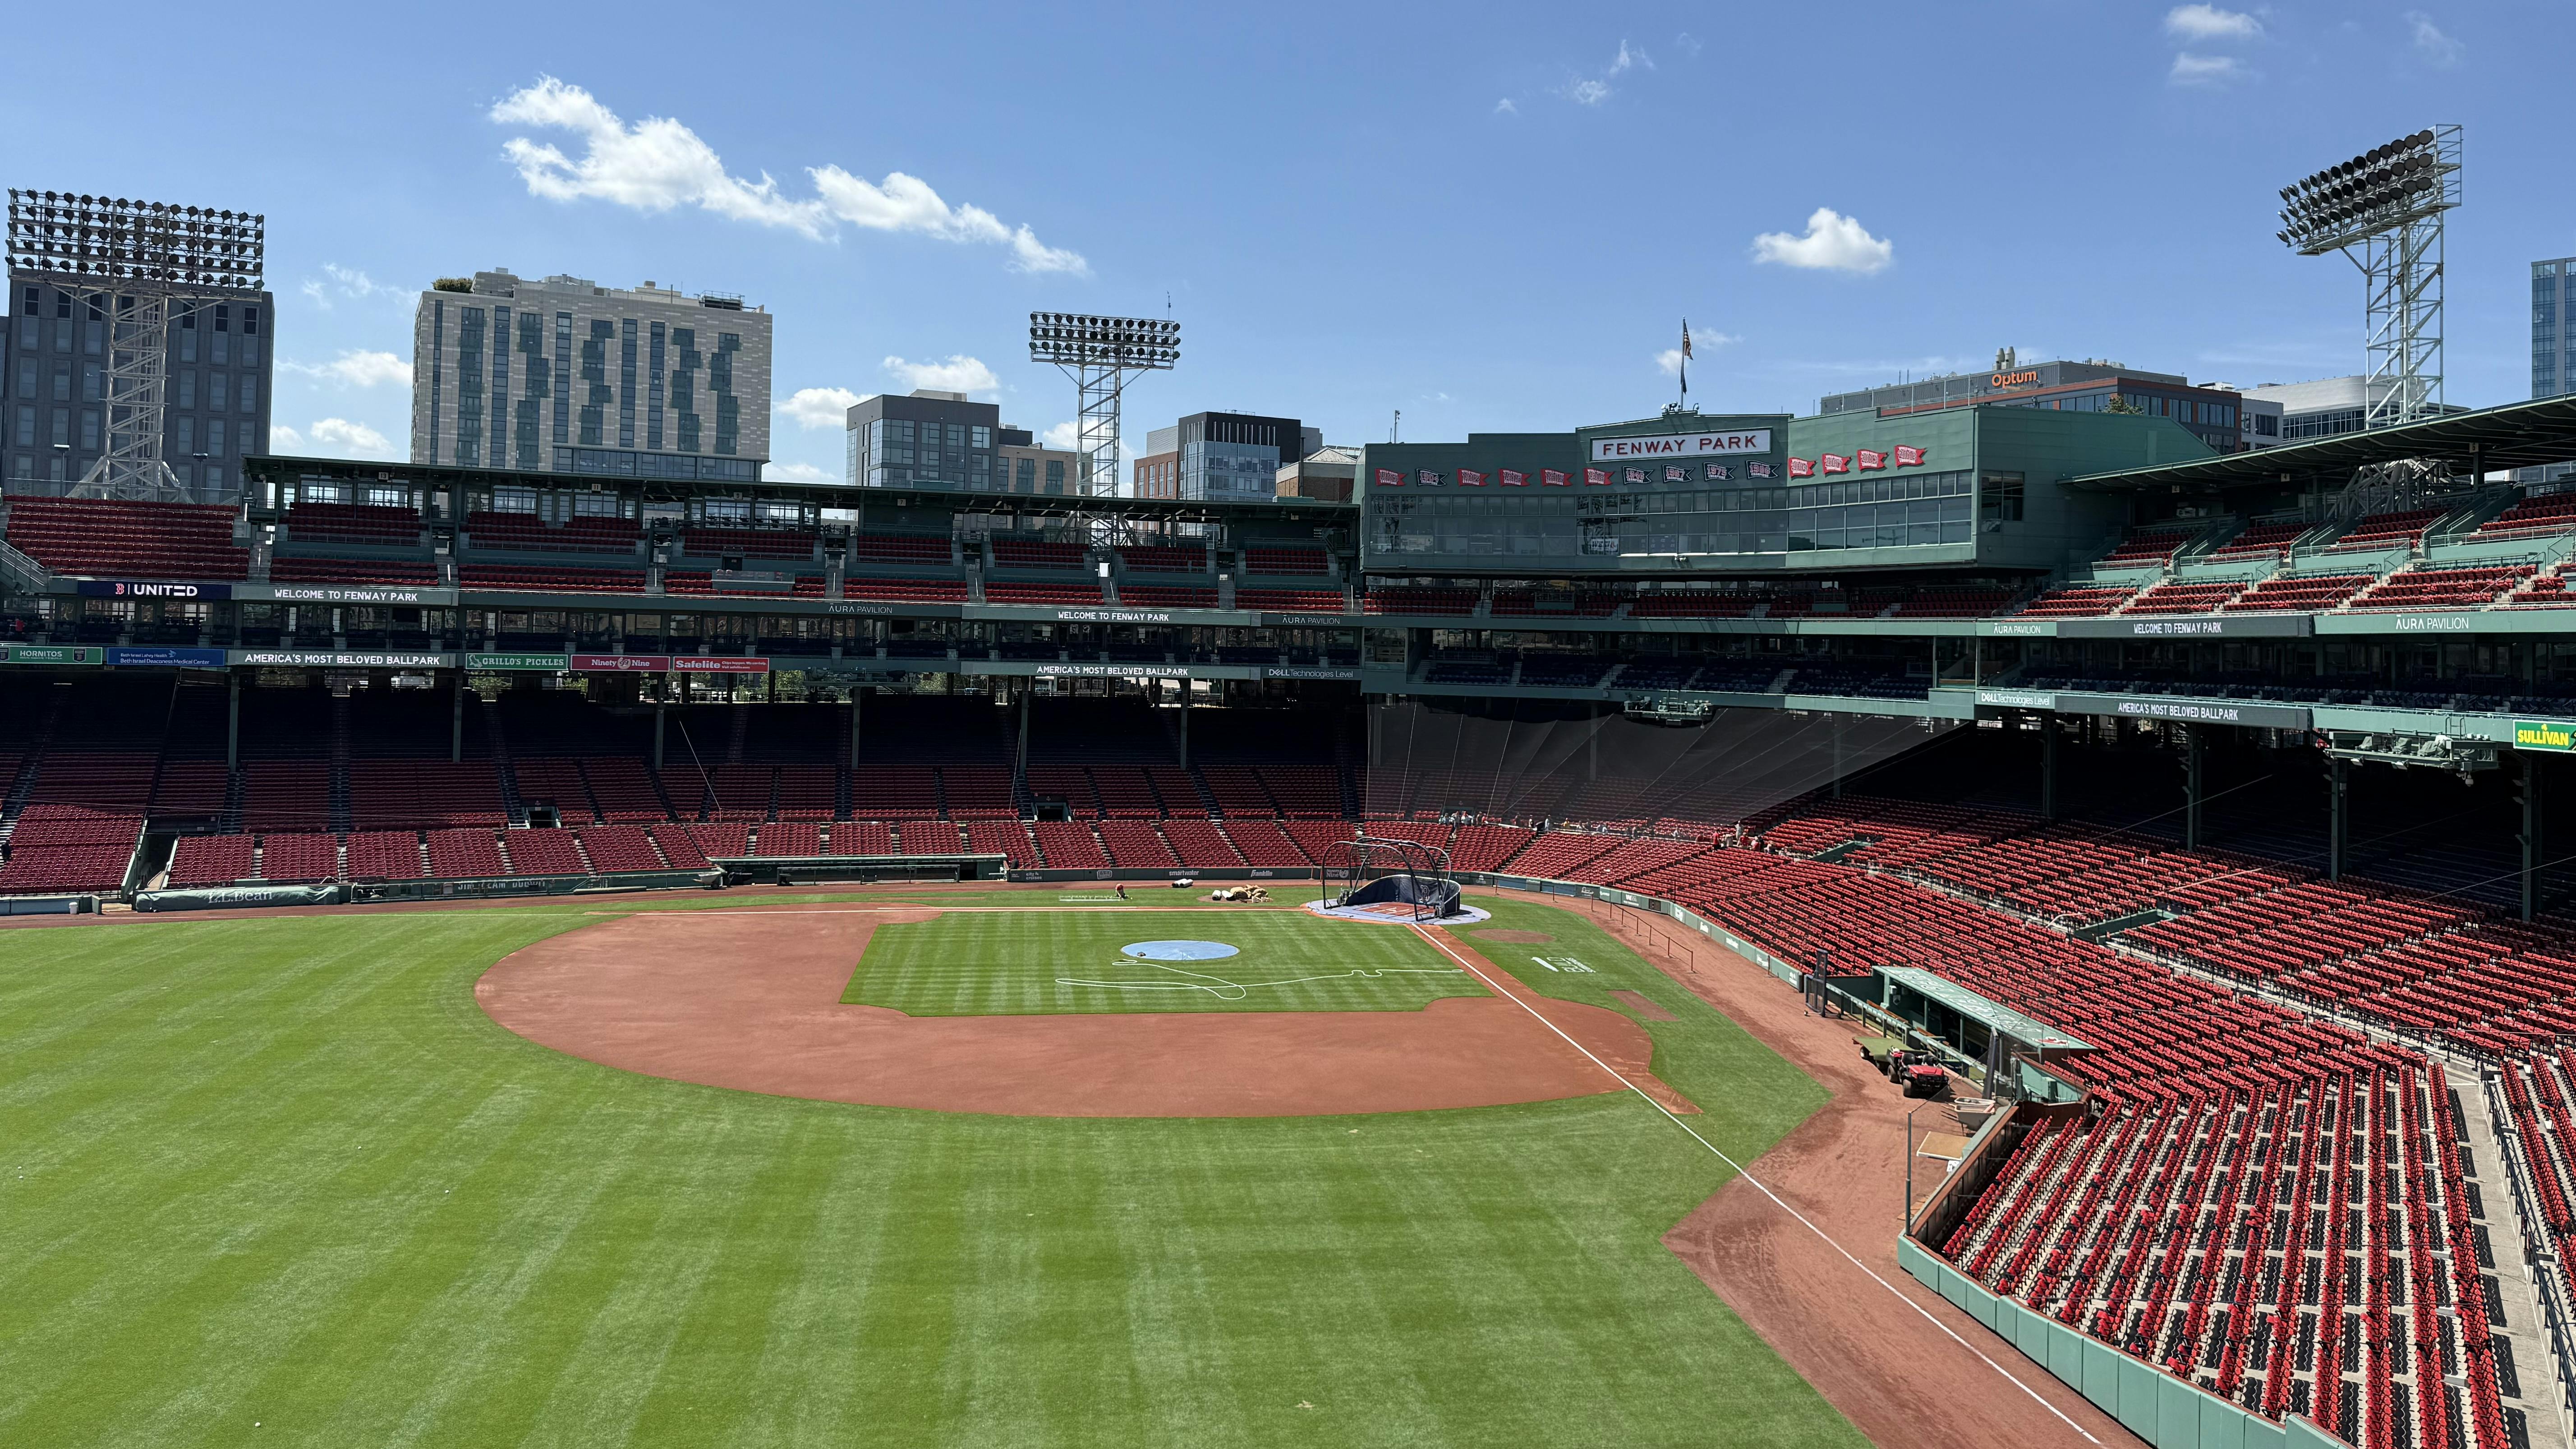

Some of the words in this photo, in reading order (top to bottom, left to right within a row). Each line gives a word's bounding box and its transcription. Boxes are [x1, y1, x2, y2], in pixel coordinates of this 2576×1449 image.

[1992, 371, 2037, 390] Optum
[1603, 439, 1686, 456] FENWAY
[1699, 435, 1757, 450] PARK
[134, 584, 198, 596] UNITED
[275, 589, 324, 599] WELCOME
[327, 590, 341, 599] TO
[344, 591, 387, 600] FENWAY
[391, 592, 418, 602] PARK
[1058, 611, 1096, 620] WELCOME
[1112, 612, 1145, 621] FENWAY
[1147, 613, 1169, 621] PARK
[2134, 623, 2162, 634] WELCOME
[2164, 623, 2172, 634] TO
[2174, 622, 2201, 634] FENWAY
[2203, 622, 2222, 633] PARK
[2427, 617, 2469, 630] PAVILION
[2014, 626, 2041, 634] PAVILION
[245, 653, 301, 663] AMERICA'S
[305, 654, 333, 664] MOST
[337, 655, 383, 664] BELOVED
[386, 656, 440, 665] BALLPARK
[676, 661, 721, 669] Safelite
[1108, 667, 1143, 675] BELOVED
[1146, 667, 1188, 676] BALLPARK
[2034, 695, 2050, 705] Level
[2118, 702, 2149, 714] AMERICA'S
[2151, 704, 2168, 715] MOST
[2170, 705, 2199, 718] BELOVED
[2201, 707, 2238, 721] BALLPARK
[2517, 728, 2569, 746] SULLIVAN
[208, 891, 272, 903] L.L.Bean
